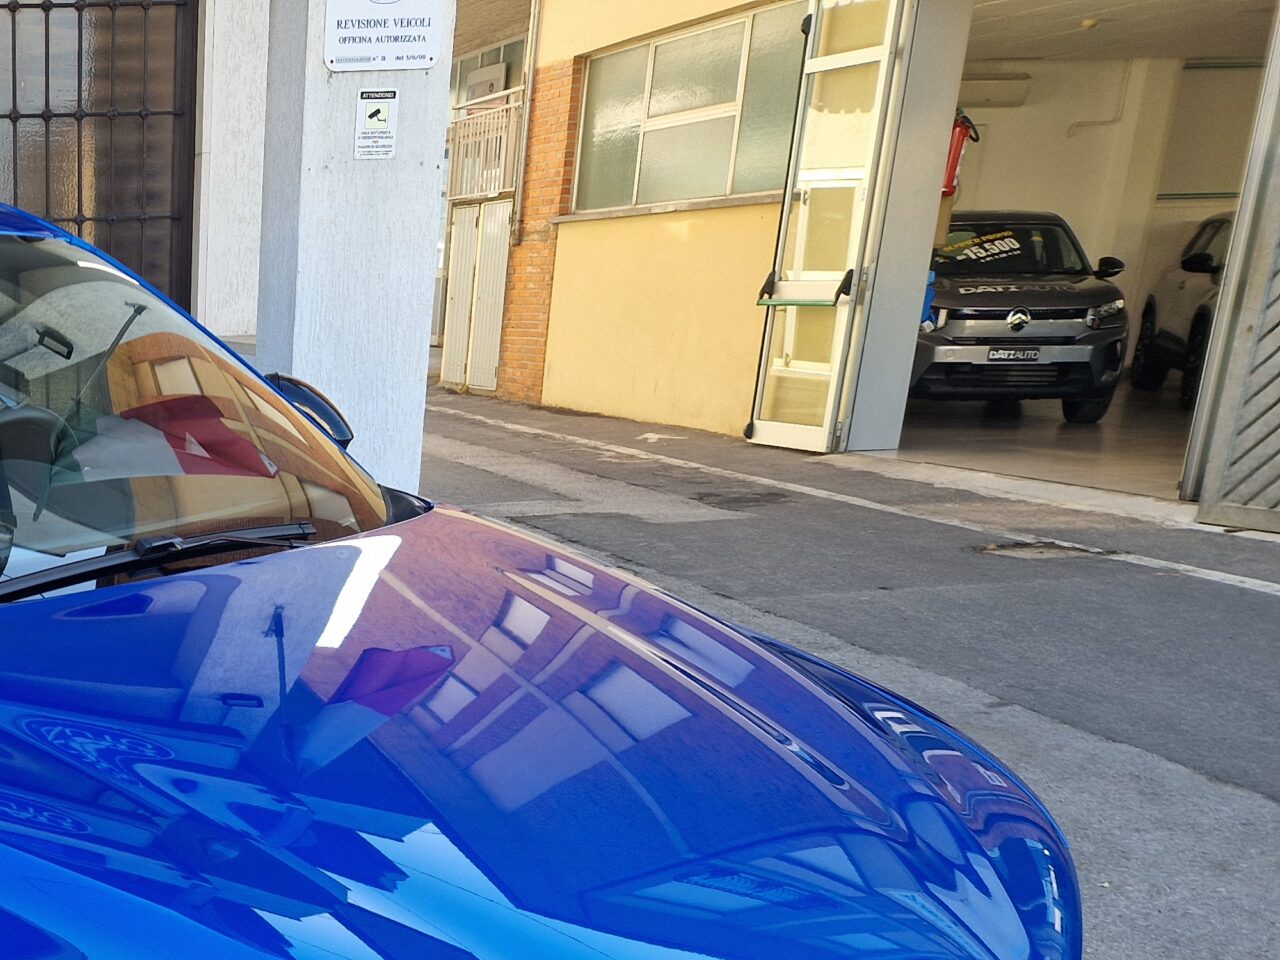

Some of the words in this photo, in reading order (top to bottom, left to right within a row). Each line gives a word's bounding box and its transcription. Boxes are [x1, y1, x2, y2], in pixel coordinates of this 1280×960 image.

[336, 19, 390, 30] REVISIONE
[393, 17, 432, 28] VEICOLI
[338, 36, 372, 45] OFFICINA
[375, 34, 427, 43] AUTORIZZATA
[962, 237, 1021, 260] 15.500
